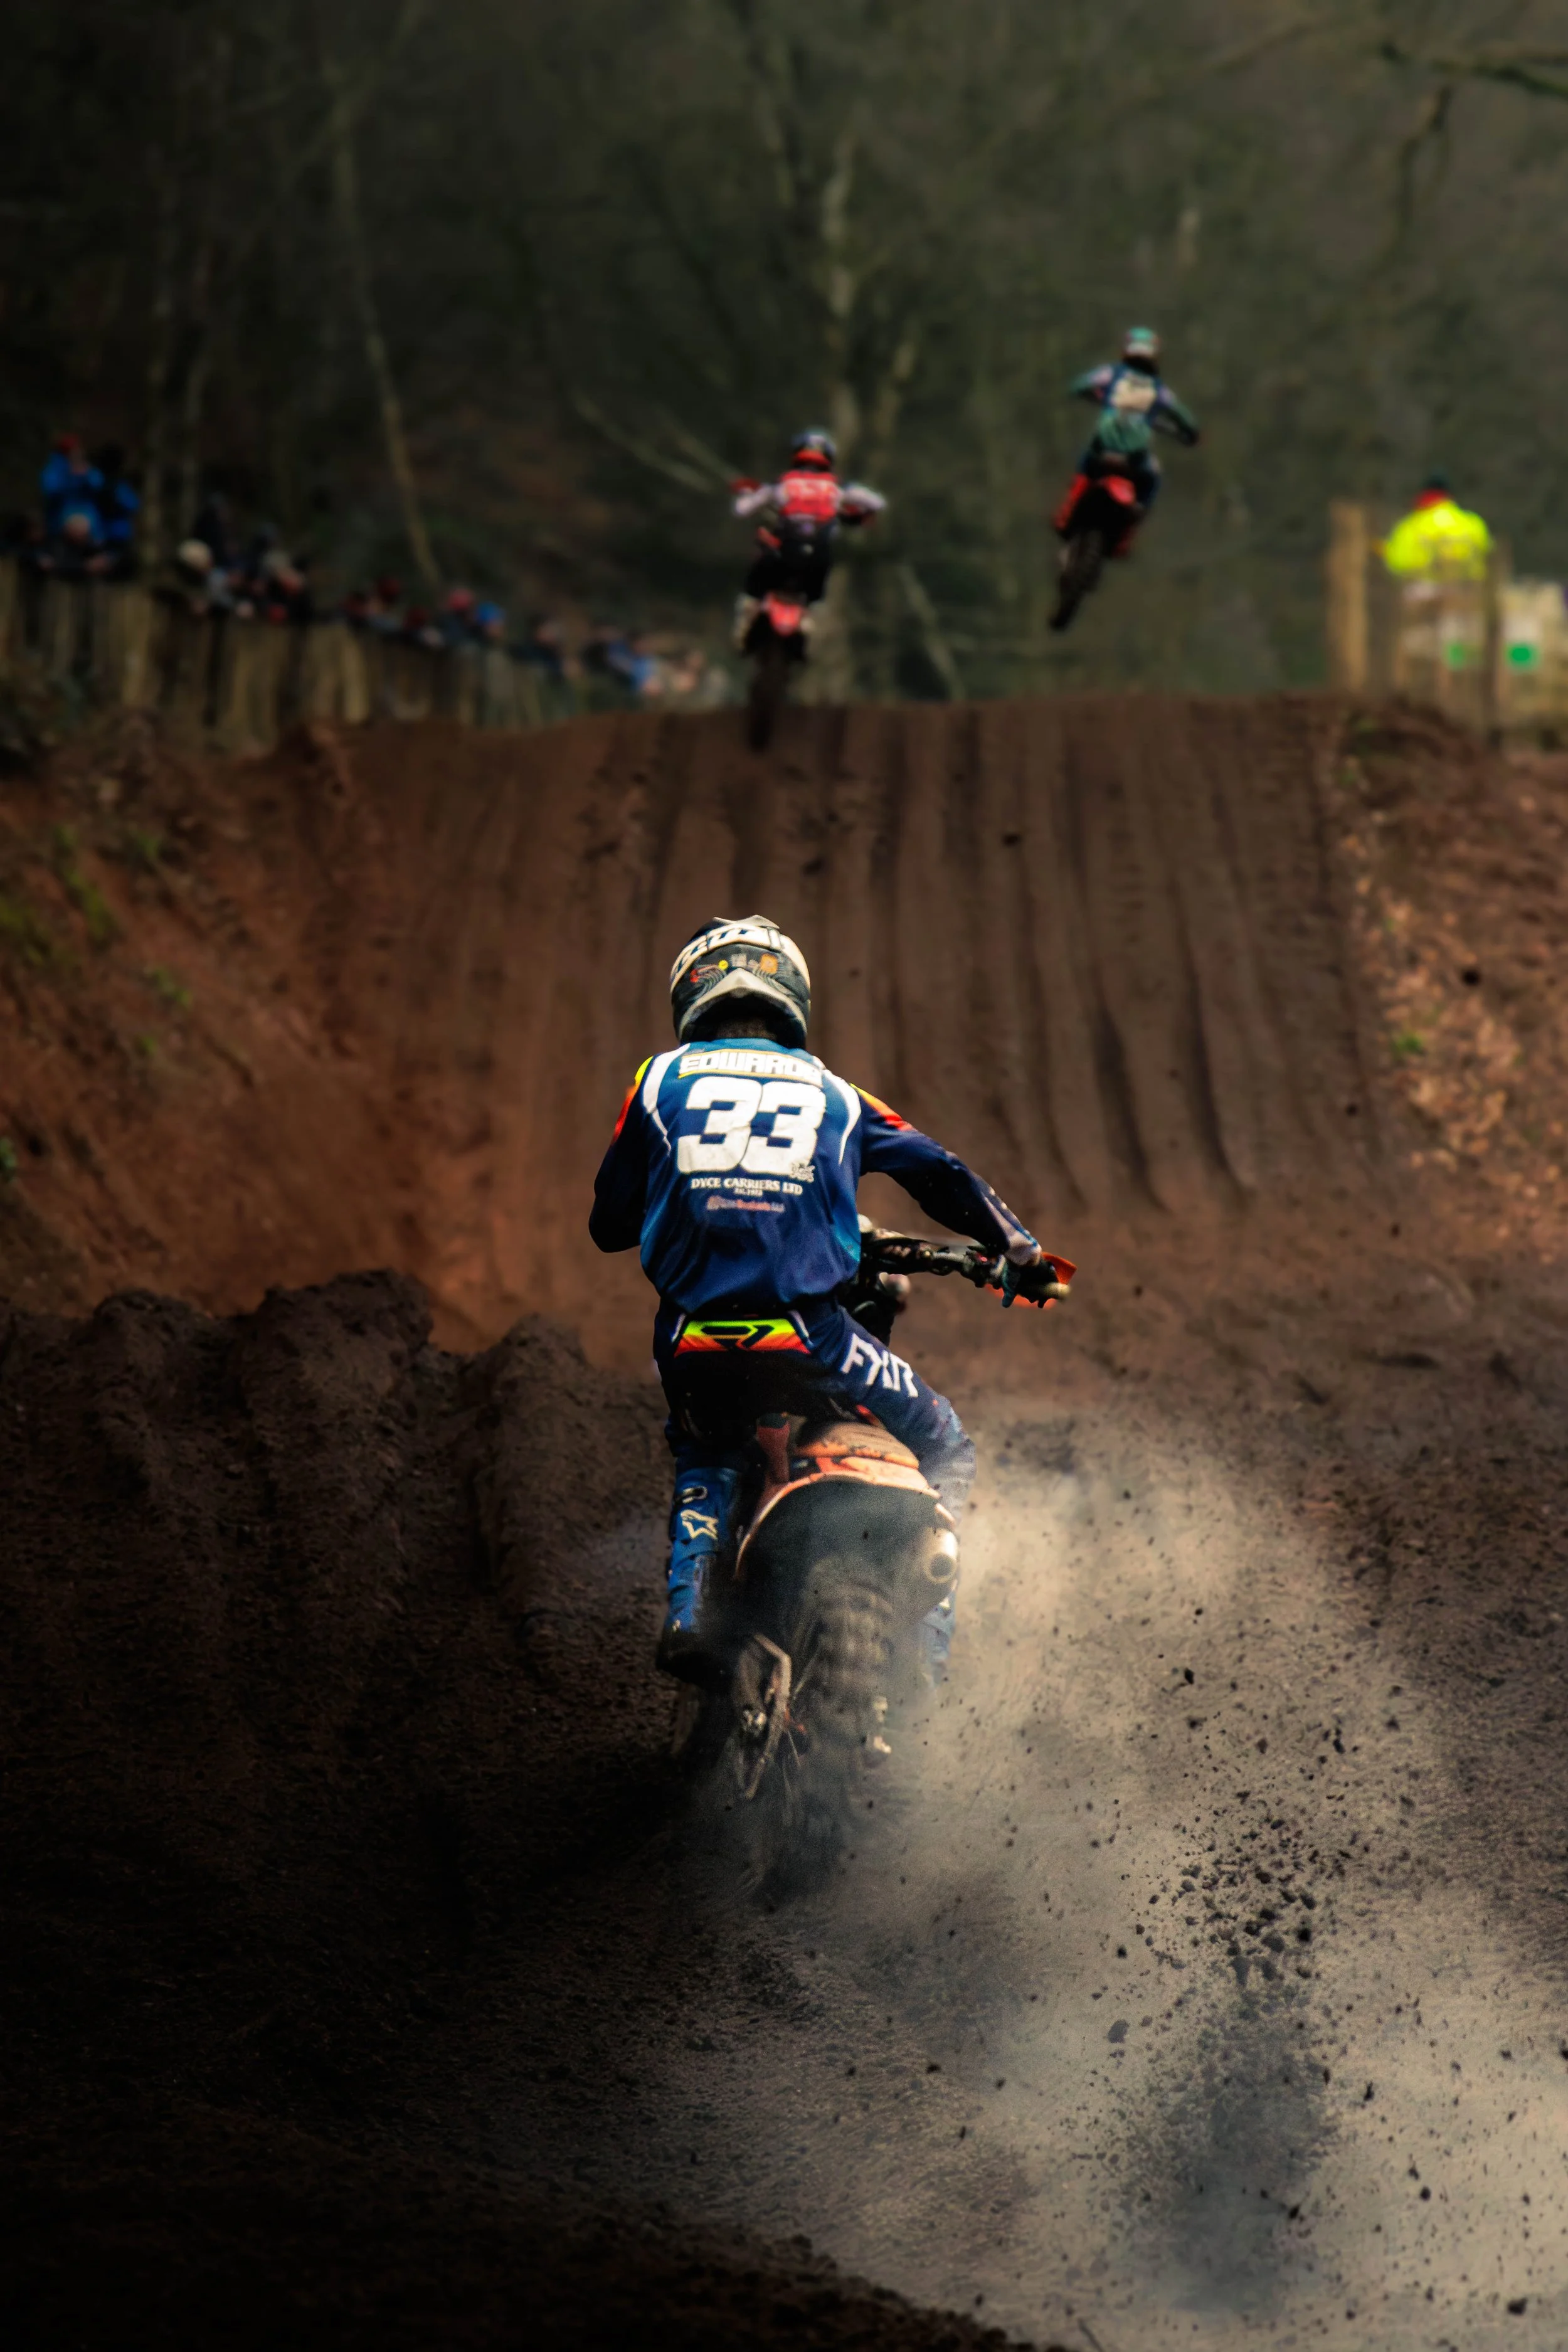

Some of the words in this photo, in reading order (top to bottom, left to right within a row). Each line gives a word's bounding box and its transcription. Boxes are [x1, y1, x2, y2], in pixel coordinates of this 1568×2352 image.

[678, 1076, 826, 1175] 33
[691, 1177, 722, 1189] DYCE
[724, 1178, 780, 1192] CARRIERS
[782, 1182, 803, 1196] LTD
[841, 1333, 918, 1398] FXR
